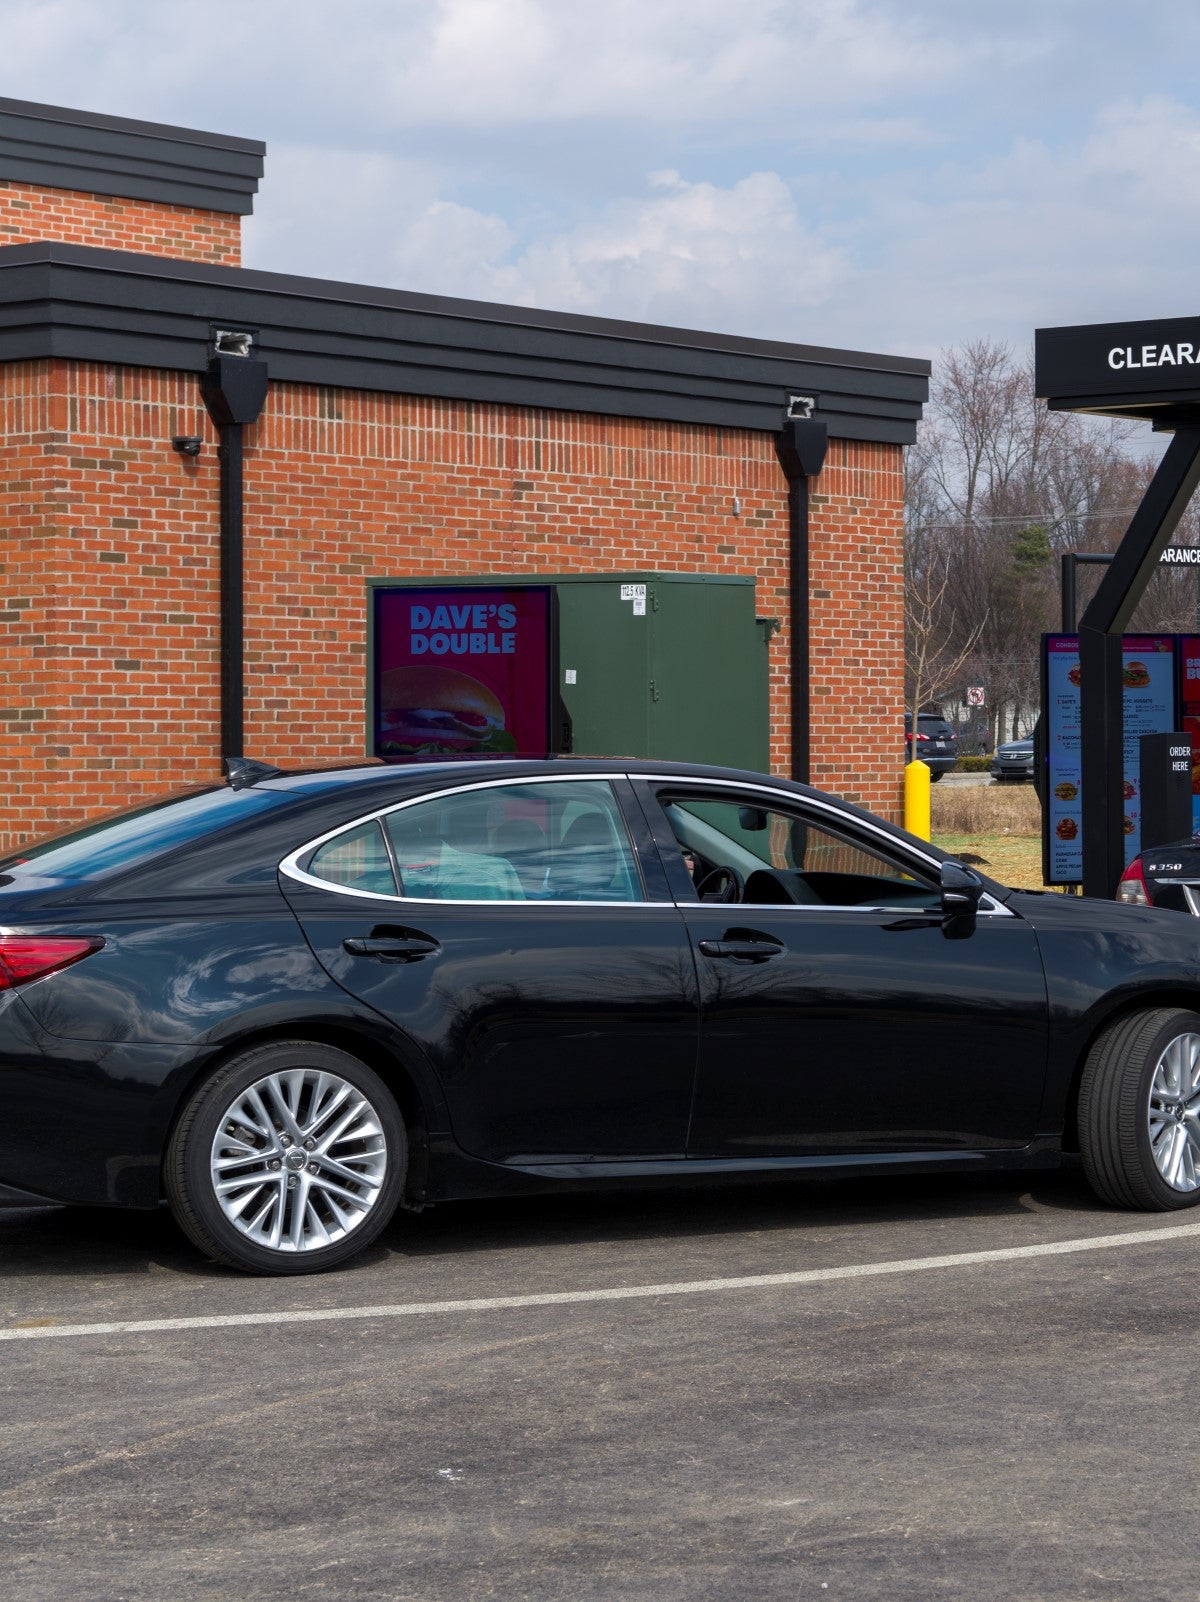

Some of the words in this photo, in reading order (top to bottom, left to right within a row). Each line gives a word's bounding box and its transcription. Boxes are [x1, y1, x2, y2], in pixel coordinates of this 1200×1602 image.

[410, 632, 516, 655] DOUBLE
[1169, 746, 1191, 757] ORDER
[1172, 761, 1189, 771] HERE
